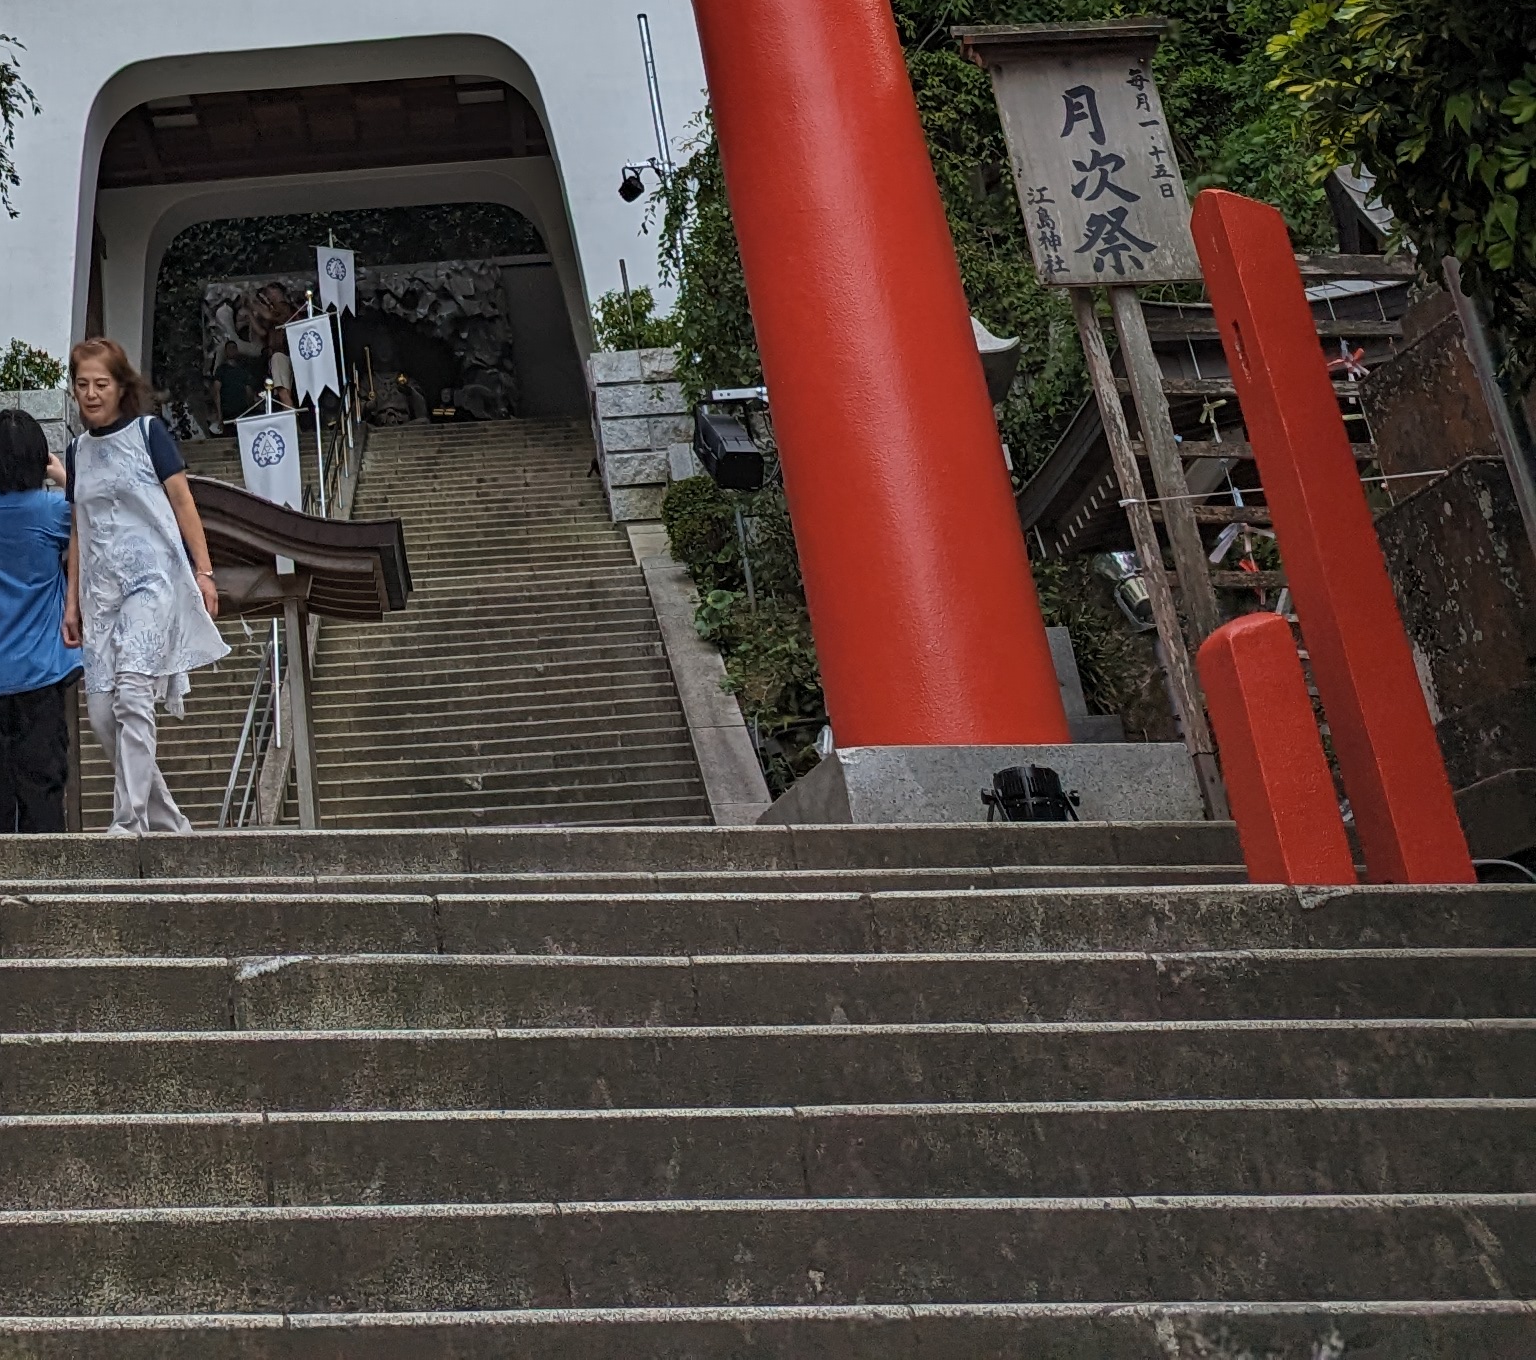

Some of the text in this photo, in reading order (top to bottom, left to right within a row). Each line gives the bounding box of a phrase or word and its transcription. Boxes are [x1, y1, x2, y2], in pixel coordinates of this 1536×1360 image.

[1026, 186, 1071, 275] 江島神社
[1060, 85, 1158, 275] 月次祭
